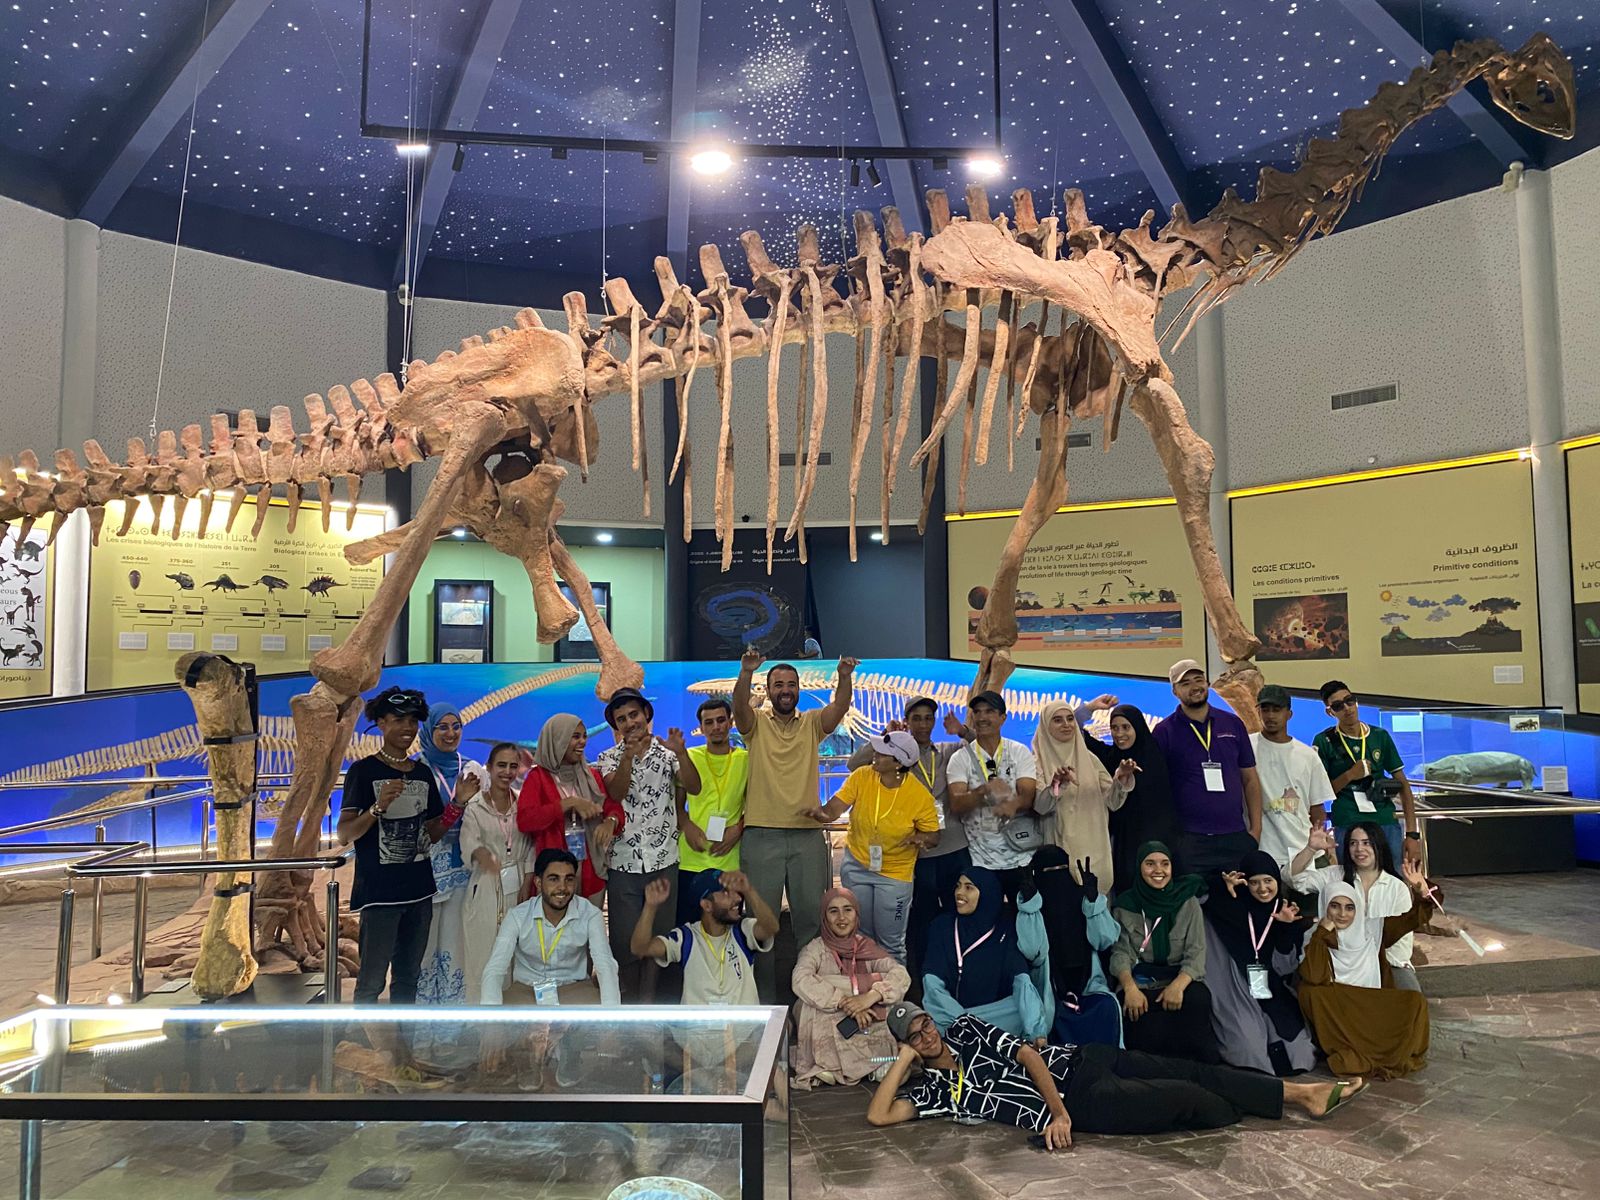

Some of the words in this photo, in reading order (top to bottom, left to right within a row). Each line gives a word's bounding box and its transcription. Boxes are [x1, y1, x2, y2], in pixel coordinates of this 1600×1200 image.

[144, 538, 183, 548] biologiques
[1086, 542, 1103, 550] الحياة
[1104, 540, 1119, 549] تطور
[1482, 543, 1518, 553] الظروف
[1445, 546, 1479, 557] البدائية
[1433, 563, 1470, 572] Primitive
[1472, 558, 1519, 569] conditions
[1266, 577, 1302, 586] conditions
[1305, 574, 1340, 584] primitives
[895, 901, 903, 920] NIKE
